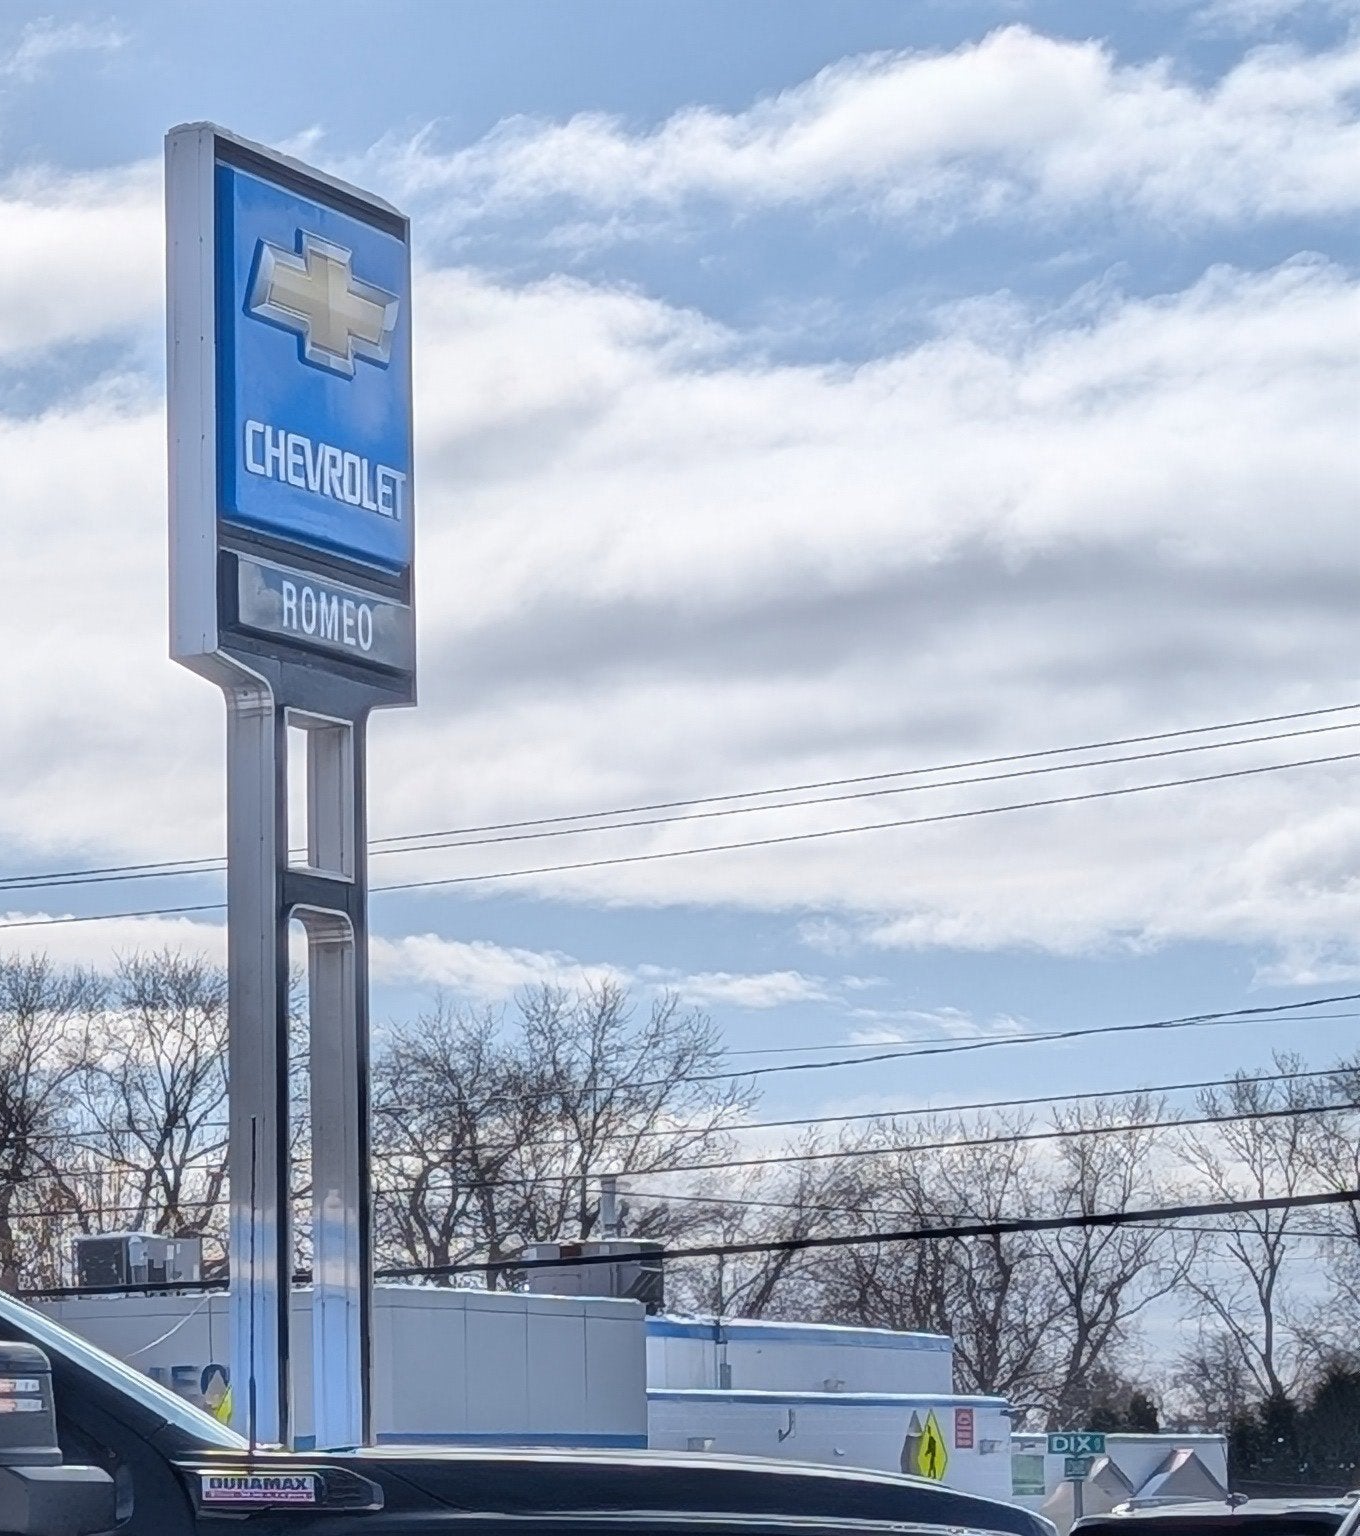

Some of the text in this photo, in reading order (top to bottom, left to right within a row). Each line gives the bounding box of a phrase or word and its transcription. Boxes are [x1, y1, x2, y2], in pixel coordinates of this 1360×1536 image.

[244, 418, 407, 521] CHEVROLET
[281, 578, 373, 652] ROMEO
[1052, 1436, 1091, 1452] DIX
[209, 1477, 307, 1490] DURAMAX
